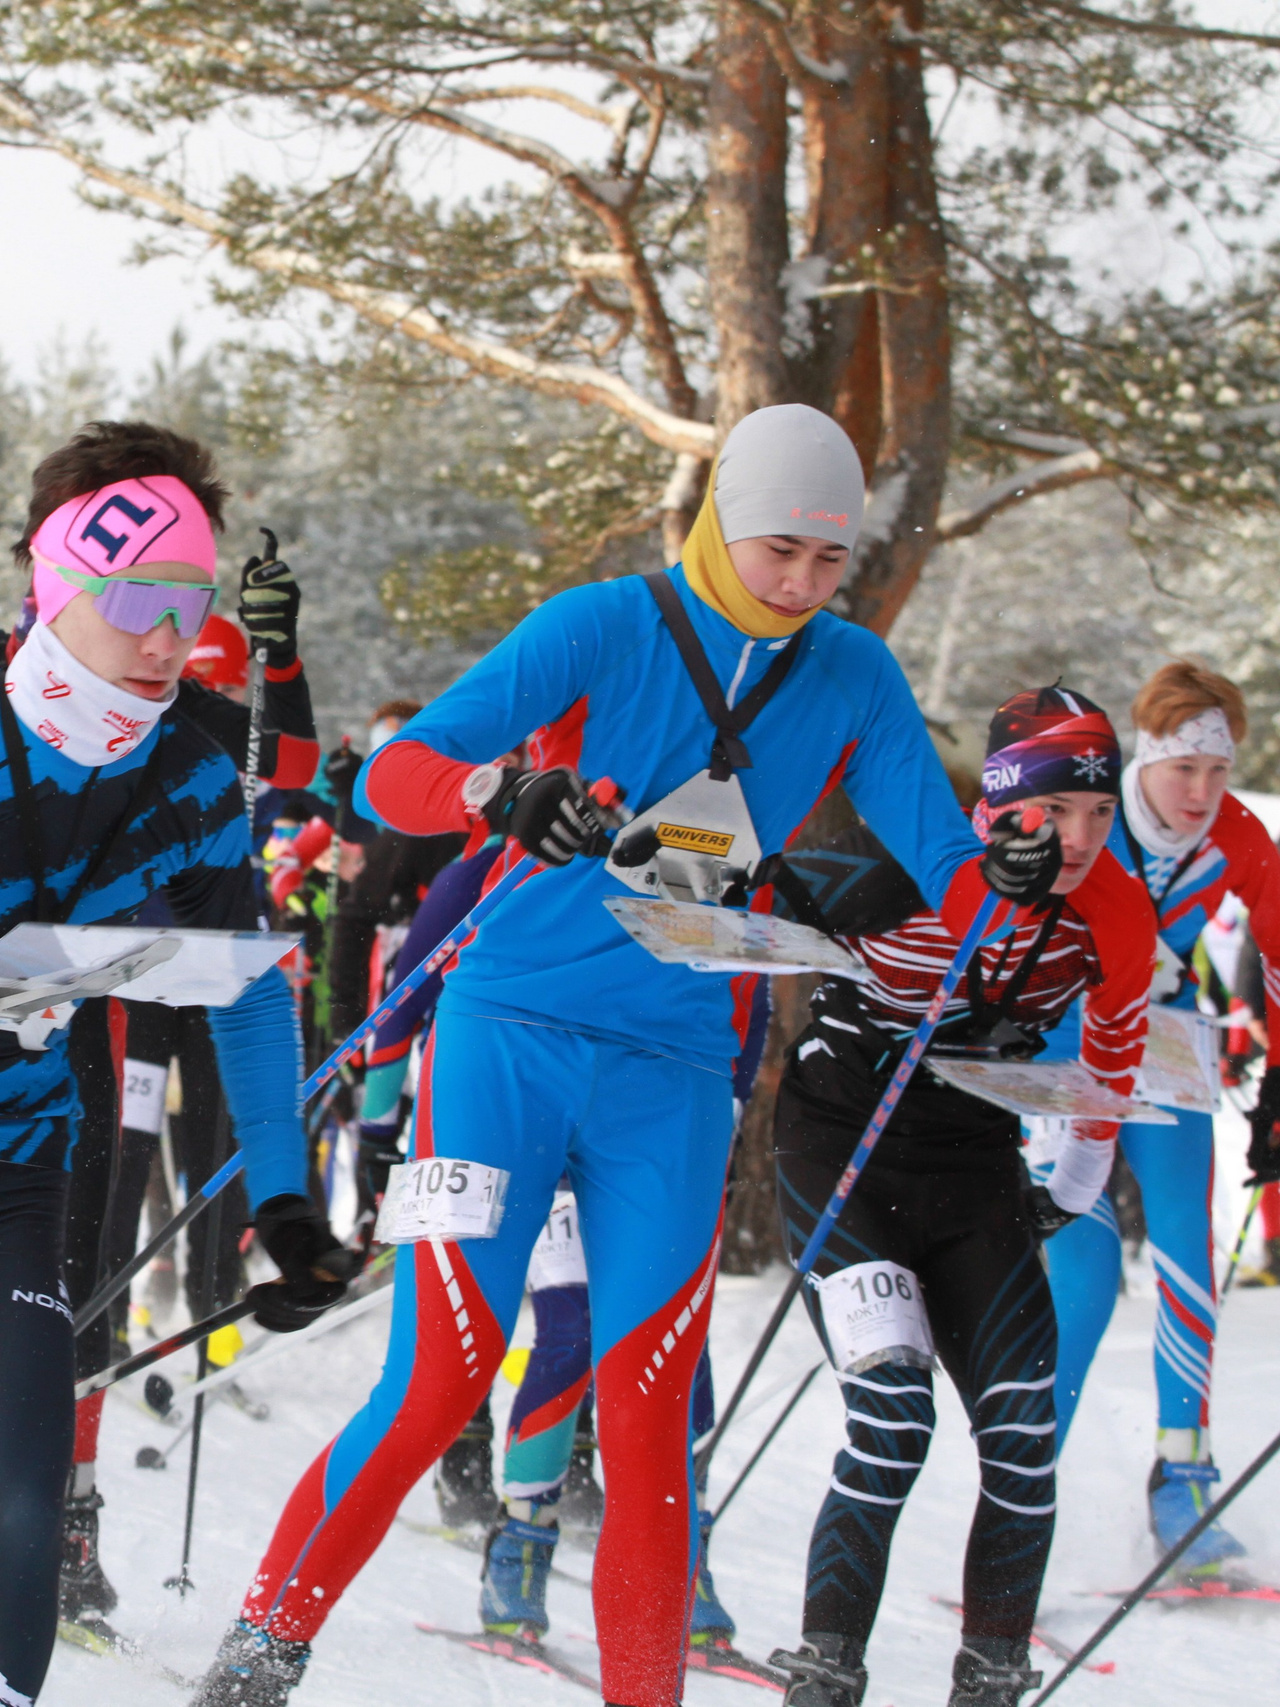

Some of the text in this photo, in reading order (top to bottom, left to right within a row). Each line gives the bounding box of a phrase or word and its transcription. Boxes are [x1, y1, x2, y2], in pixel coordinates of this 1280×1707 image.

[245, 727, 261, 830] ORDWAY
[661, 827, 730, 847] UNIVERS
[413, 1162, 471, 1196] 105
[483, 1185, 493, 1204] 1
[851, 1271, 912, 1303] 106
